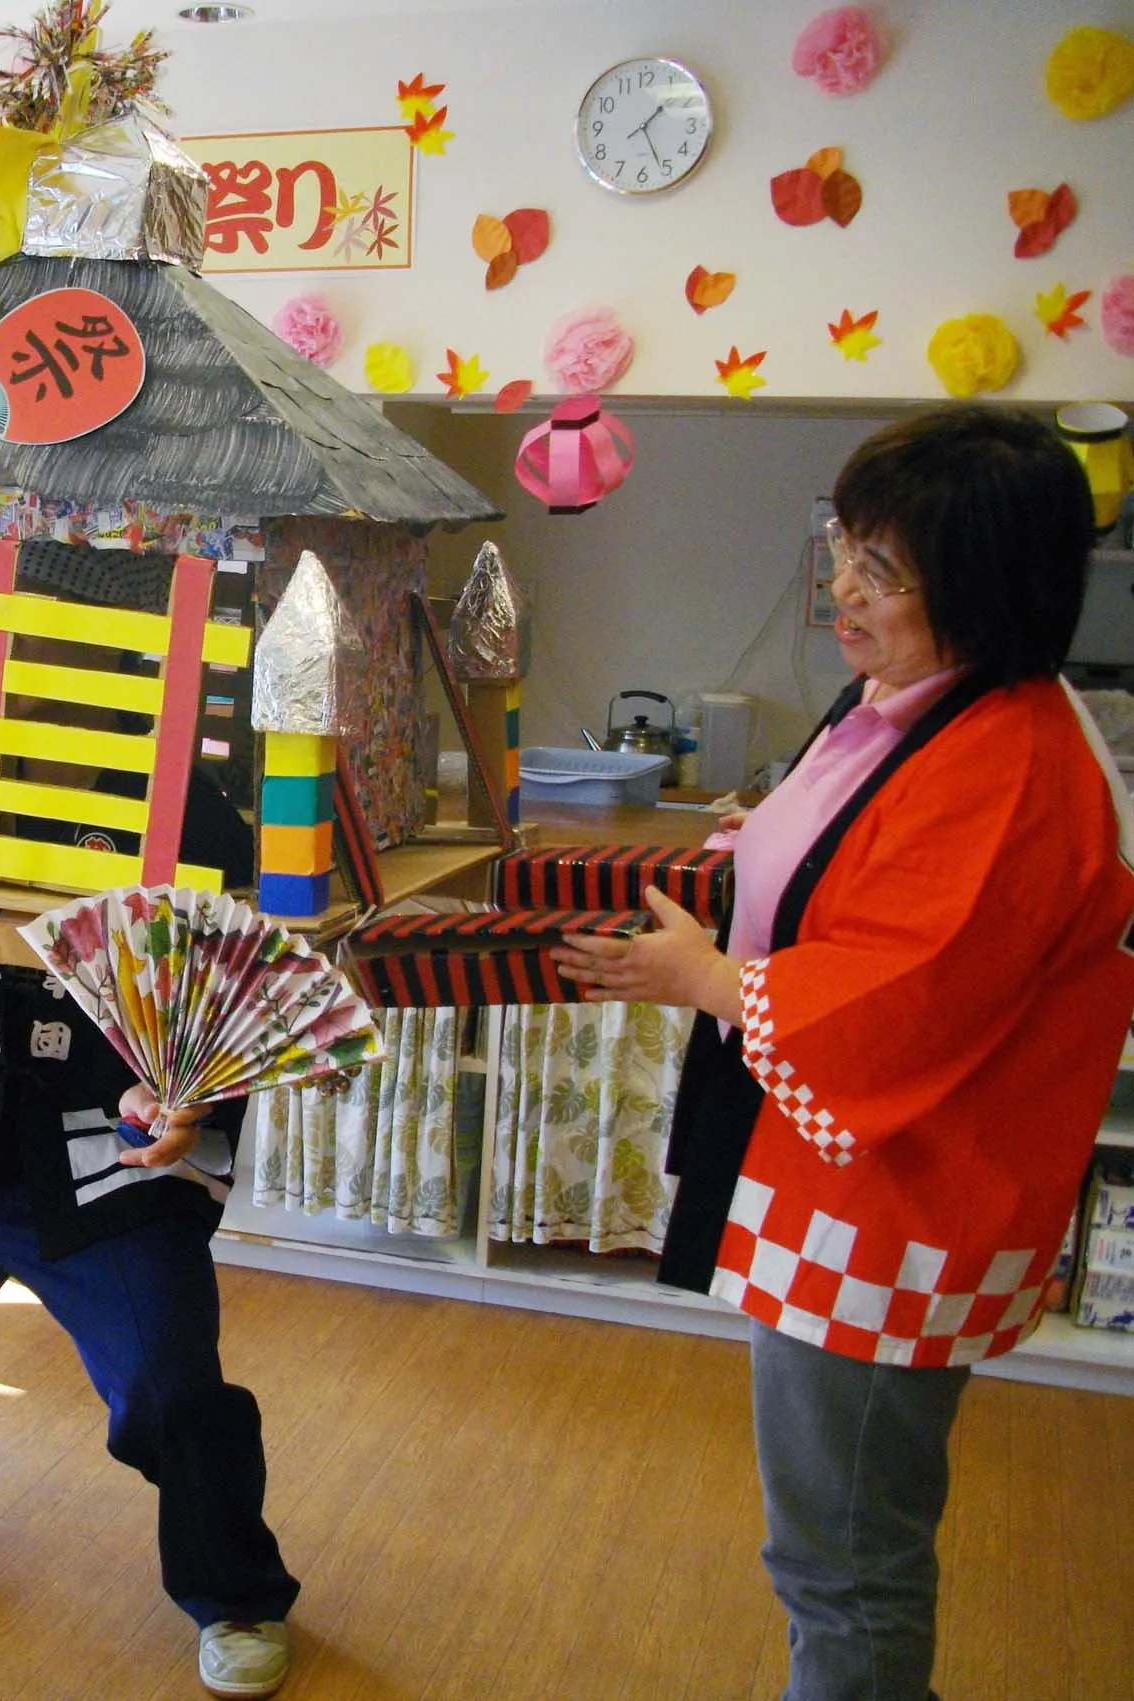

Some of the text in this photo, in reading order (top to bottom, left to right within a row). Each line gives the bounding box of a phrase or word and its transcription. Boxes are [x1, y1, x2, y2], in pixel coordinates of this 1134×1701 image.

[617, 78, 631, 95] 11
[638, 71, 655, 89] 12
[598, 96, 615, 114] 10
[592, 120, 604, 138] 9
[685, 117, 697, 135] 3
[595, 143, 607, 161] 8
[677, 140, 689, 157] 4
[615, 160, 626, 178] 7
[636, 166, 649, 184] 6
[660, 159, 673, 177] 5
[10, 315, 130, 403] 祭
